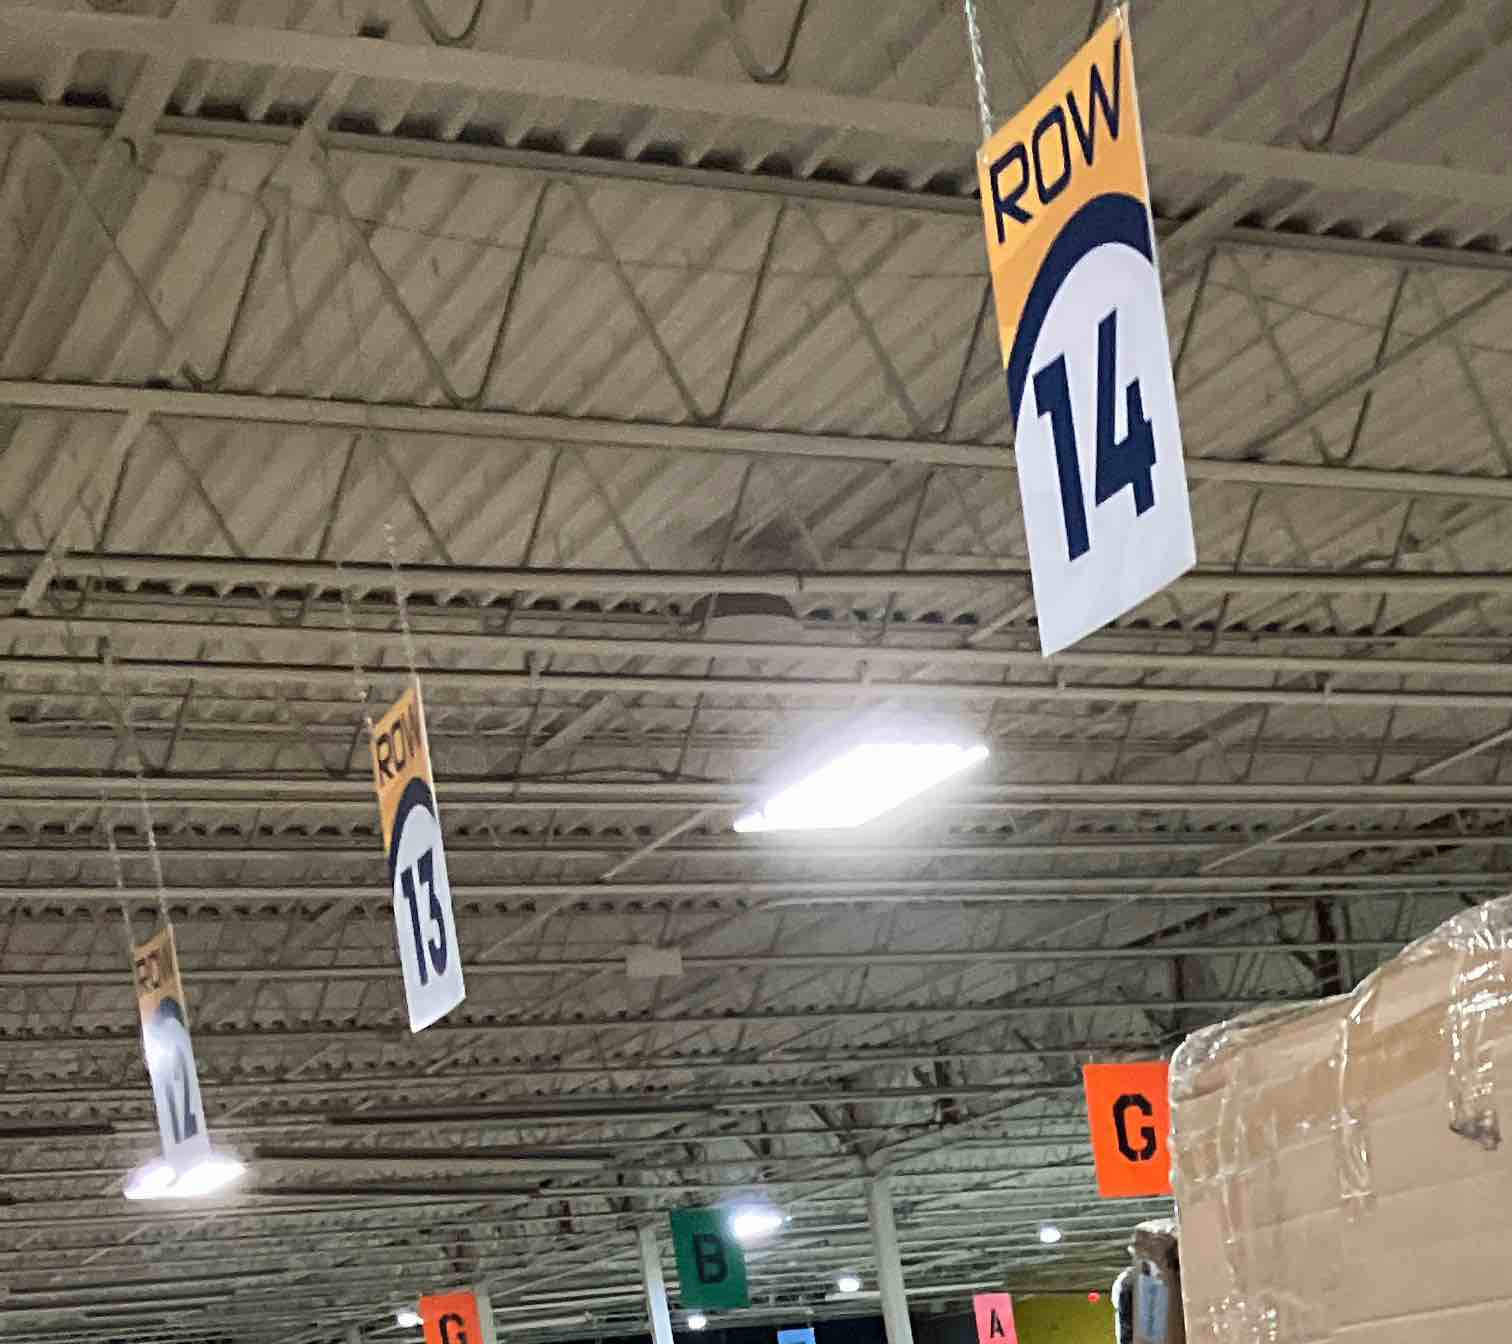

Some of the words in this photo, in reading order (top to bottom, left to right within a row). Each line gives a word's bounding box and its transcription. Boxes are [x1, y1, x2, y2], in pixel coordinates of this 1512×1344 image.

[988, 36, 1123, 244] ROW
[1033, 308, 1157, 562] 14
[376, 708, 422, 783] ROW
[401, 848, 447, 986] 13
[1112, 1093, 1158, 1162] G
[693, 1234, 728, 1283] B
[989, 1308, 1006, 1341] A
